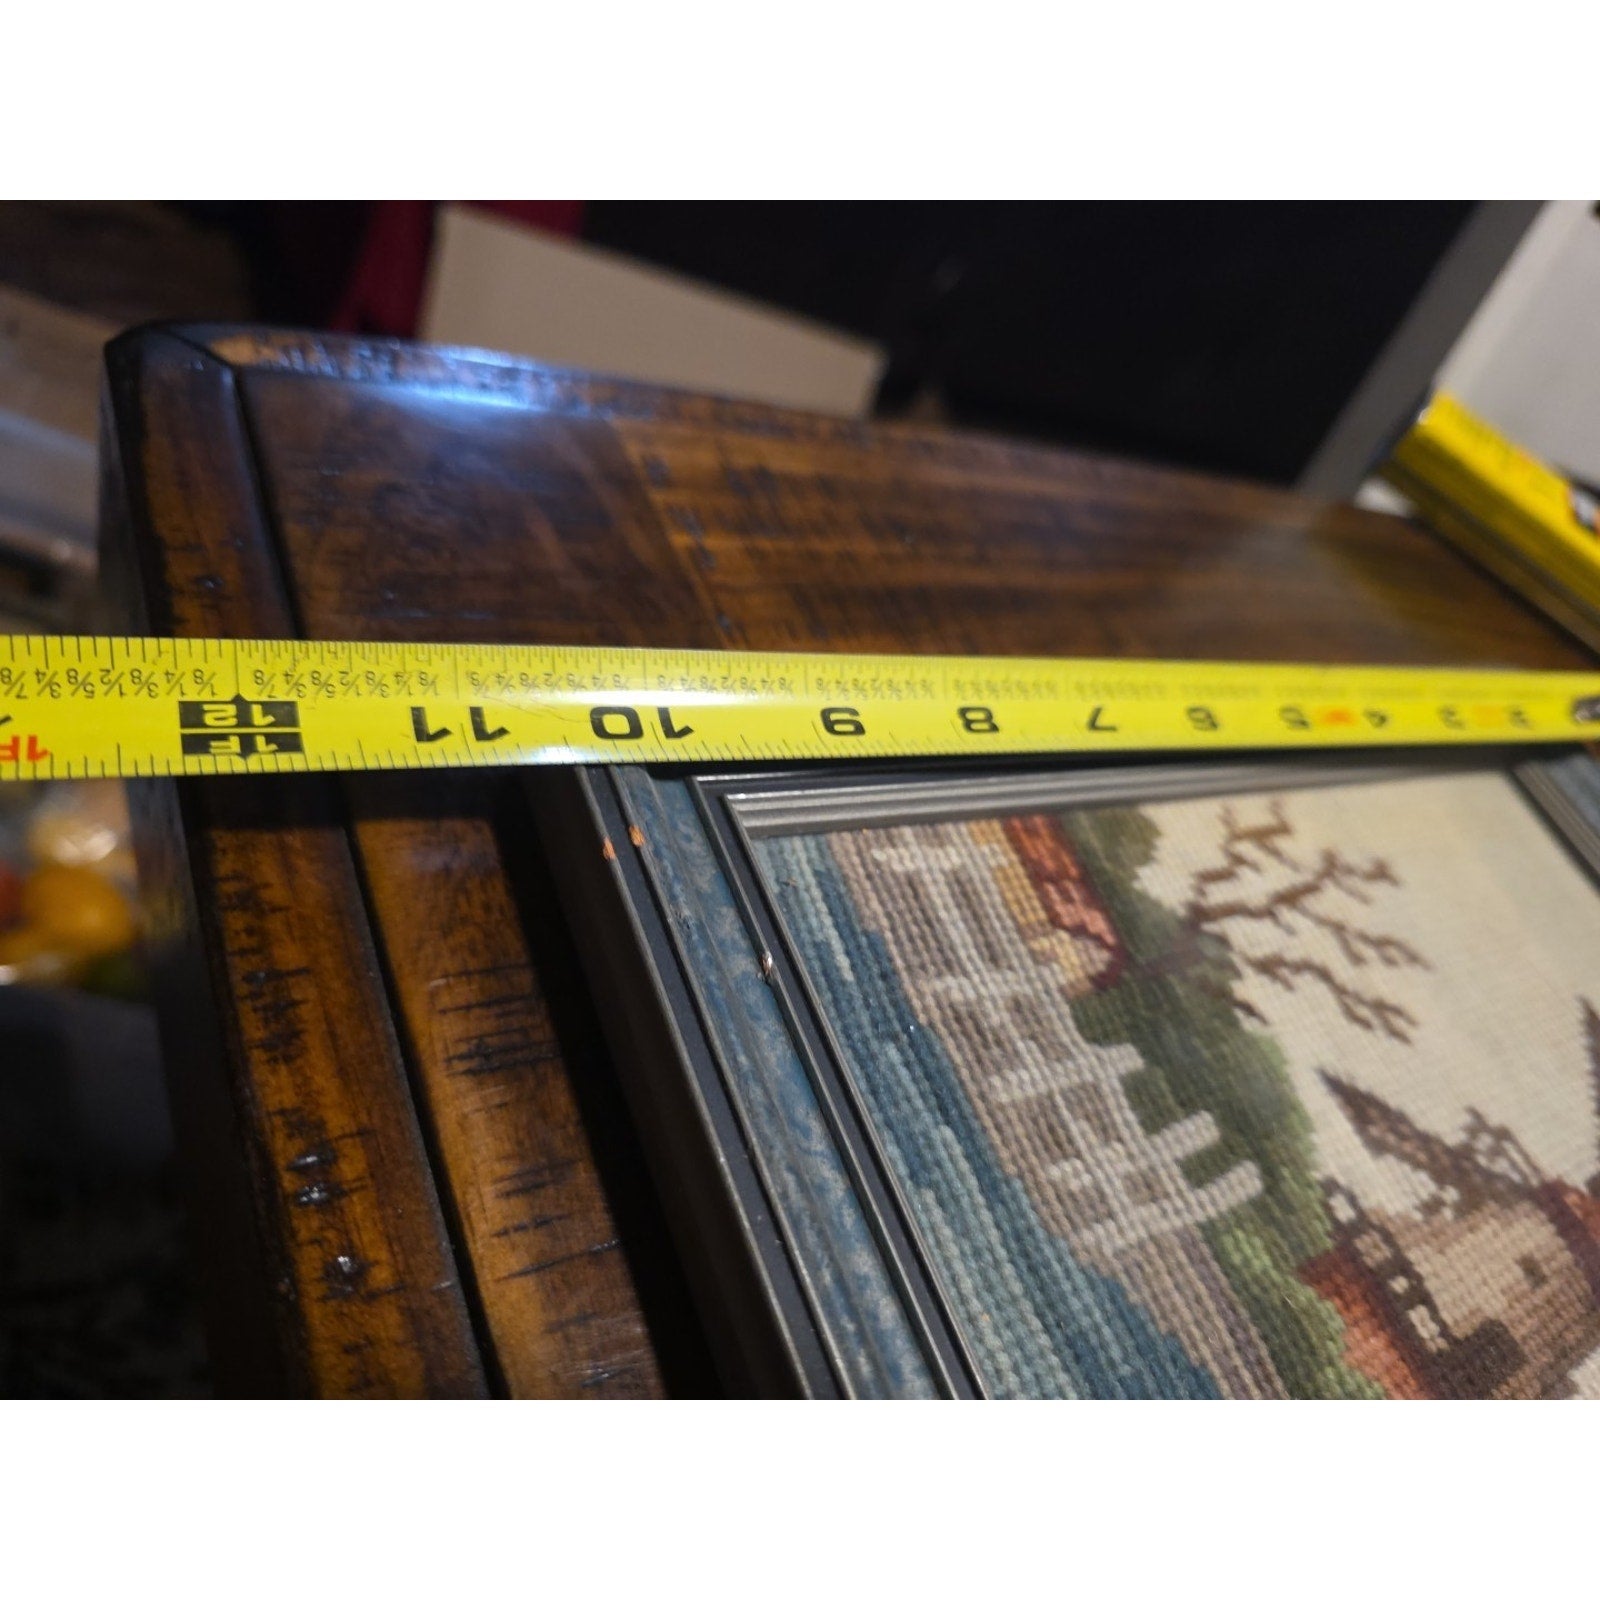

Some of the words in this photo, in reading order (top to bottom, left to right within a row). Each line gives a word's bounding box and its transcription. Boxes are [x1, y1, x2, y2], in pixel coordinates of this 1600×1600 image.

[203, 704, 275, 727] 12
[410, 706, 511, 742] 11
[590, 706, 694, 739] 10
[820, 707, 865, 736] 9
[958, 706, 999, 733] 8
[1087, 706, 1118, 731] 7
[1186, 706, 1218, 731] 6
[209, 735, 278, 754] 1F
